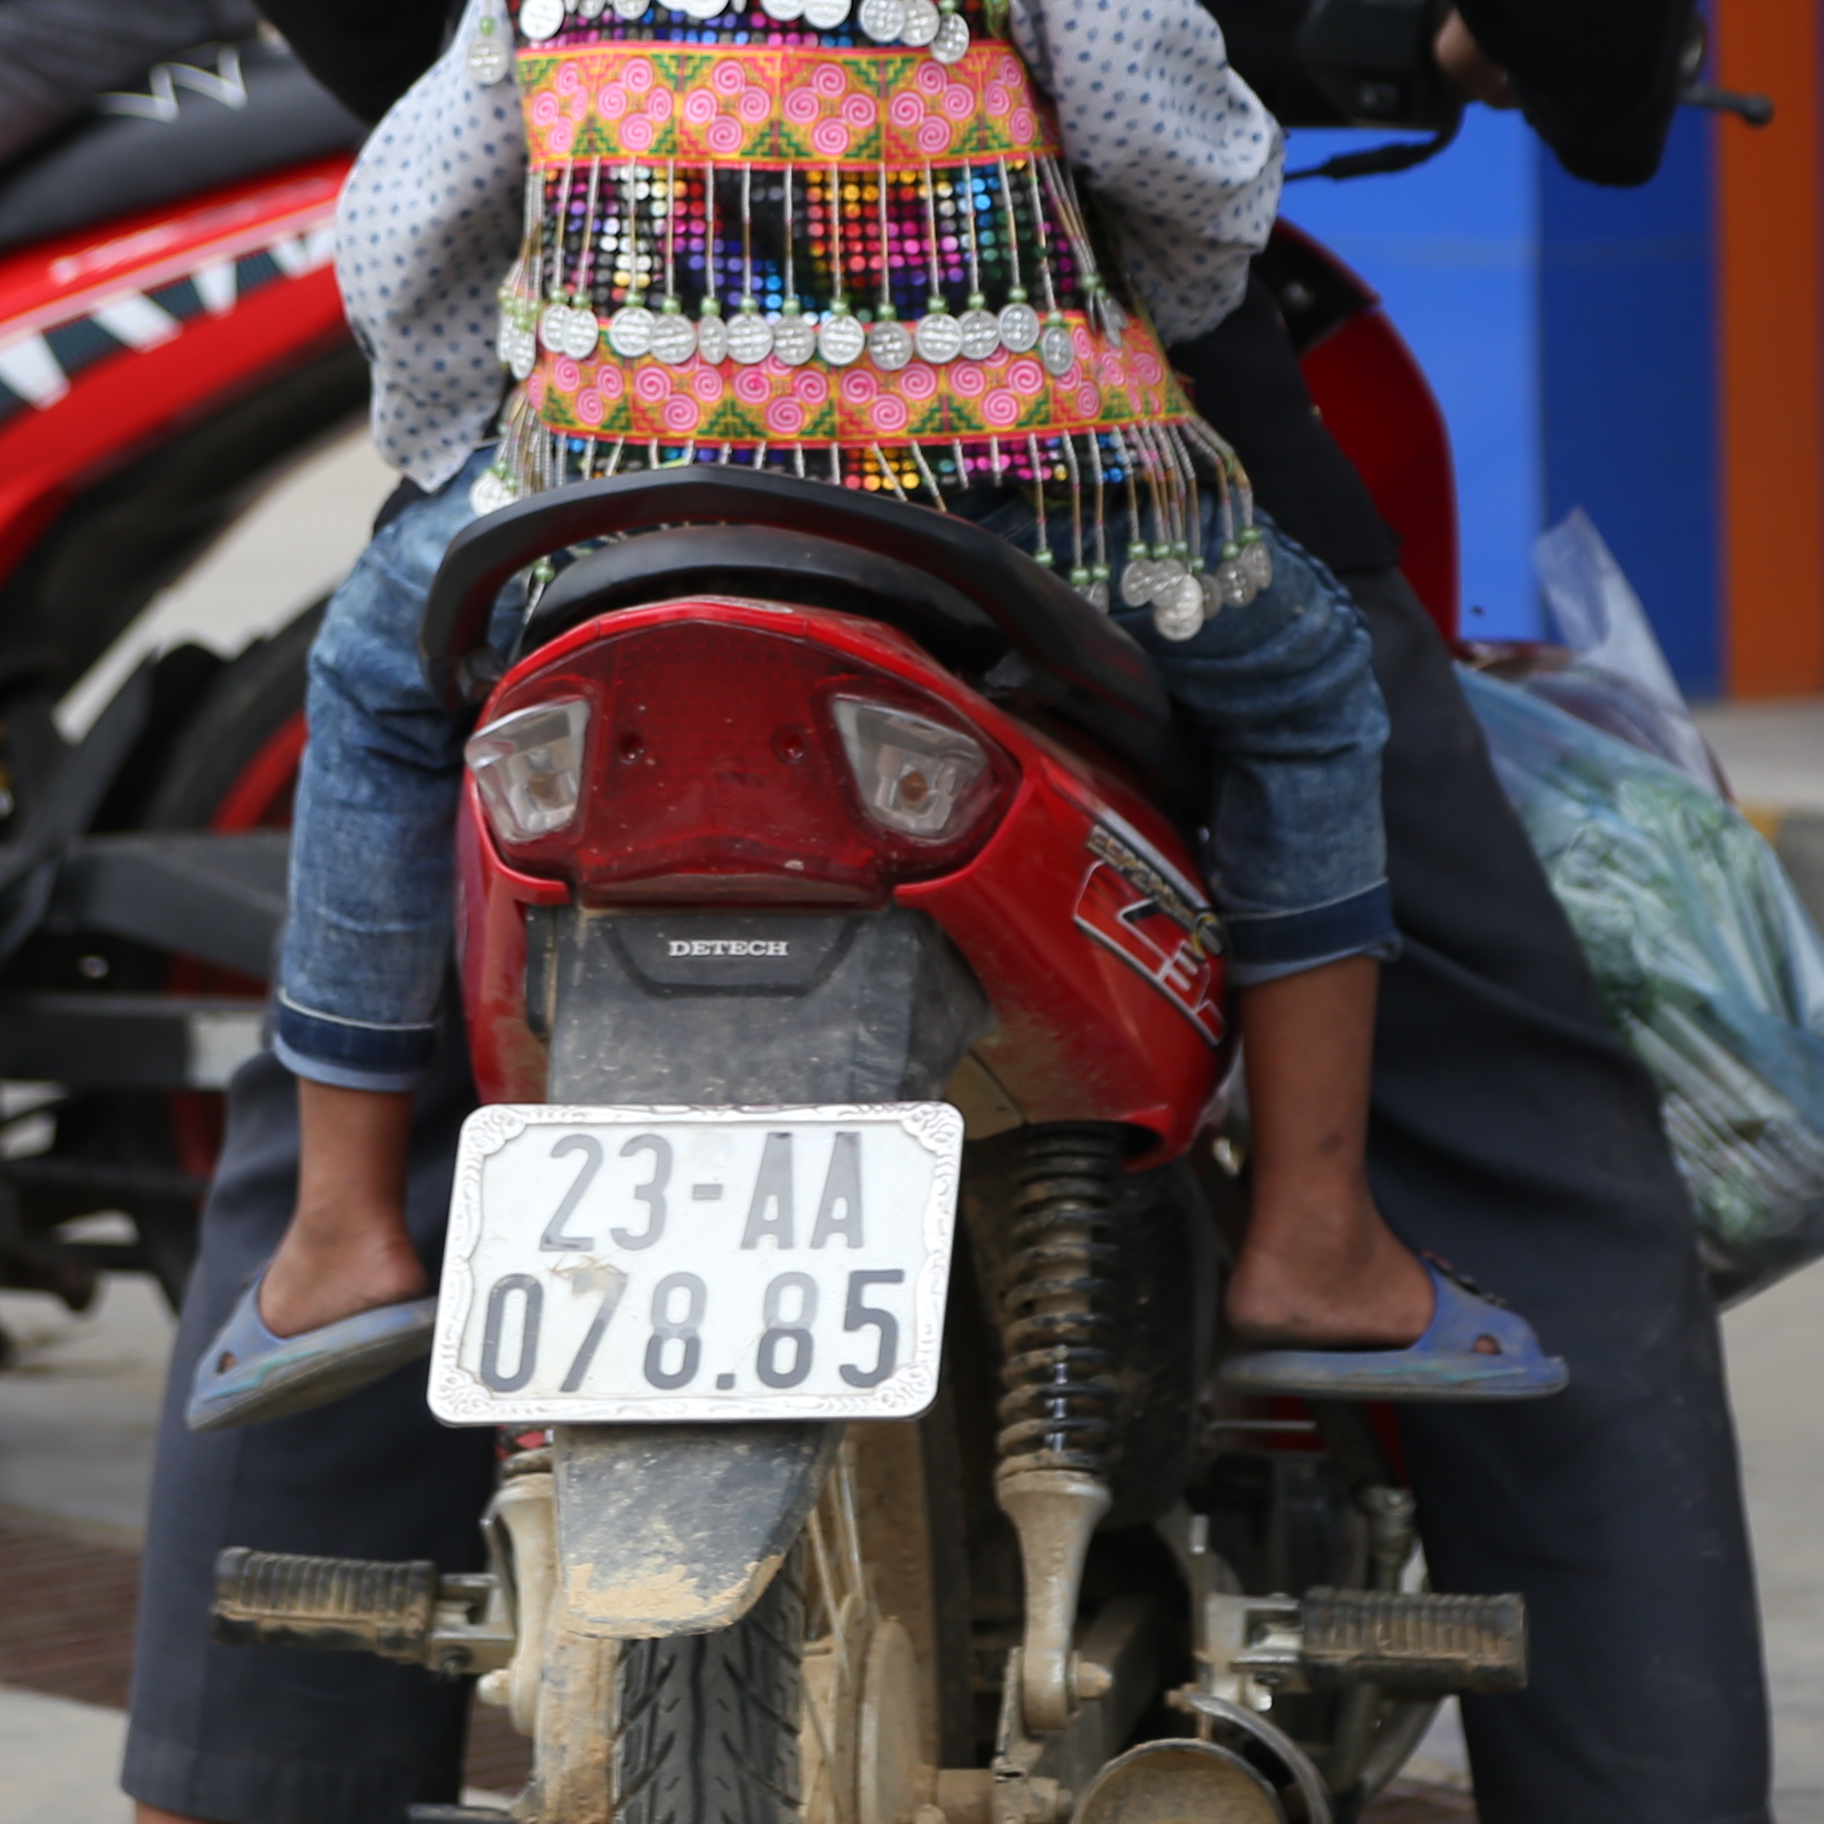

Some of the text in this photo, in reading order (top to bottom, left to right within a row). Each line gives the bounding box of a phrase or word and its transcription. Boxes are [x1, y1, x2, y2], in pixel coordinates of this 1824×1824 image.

[668, 939, 789, 957] DETECH
[539, 1131, 864, 1252] 23-AA
[479, 1268, 905, 1393] 078.85
